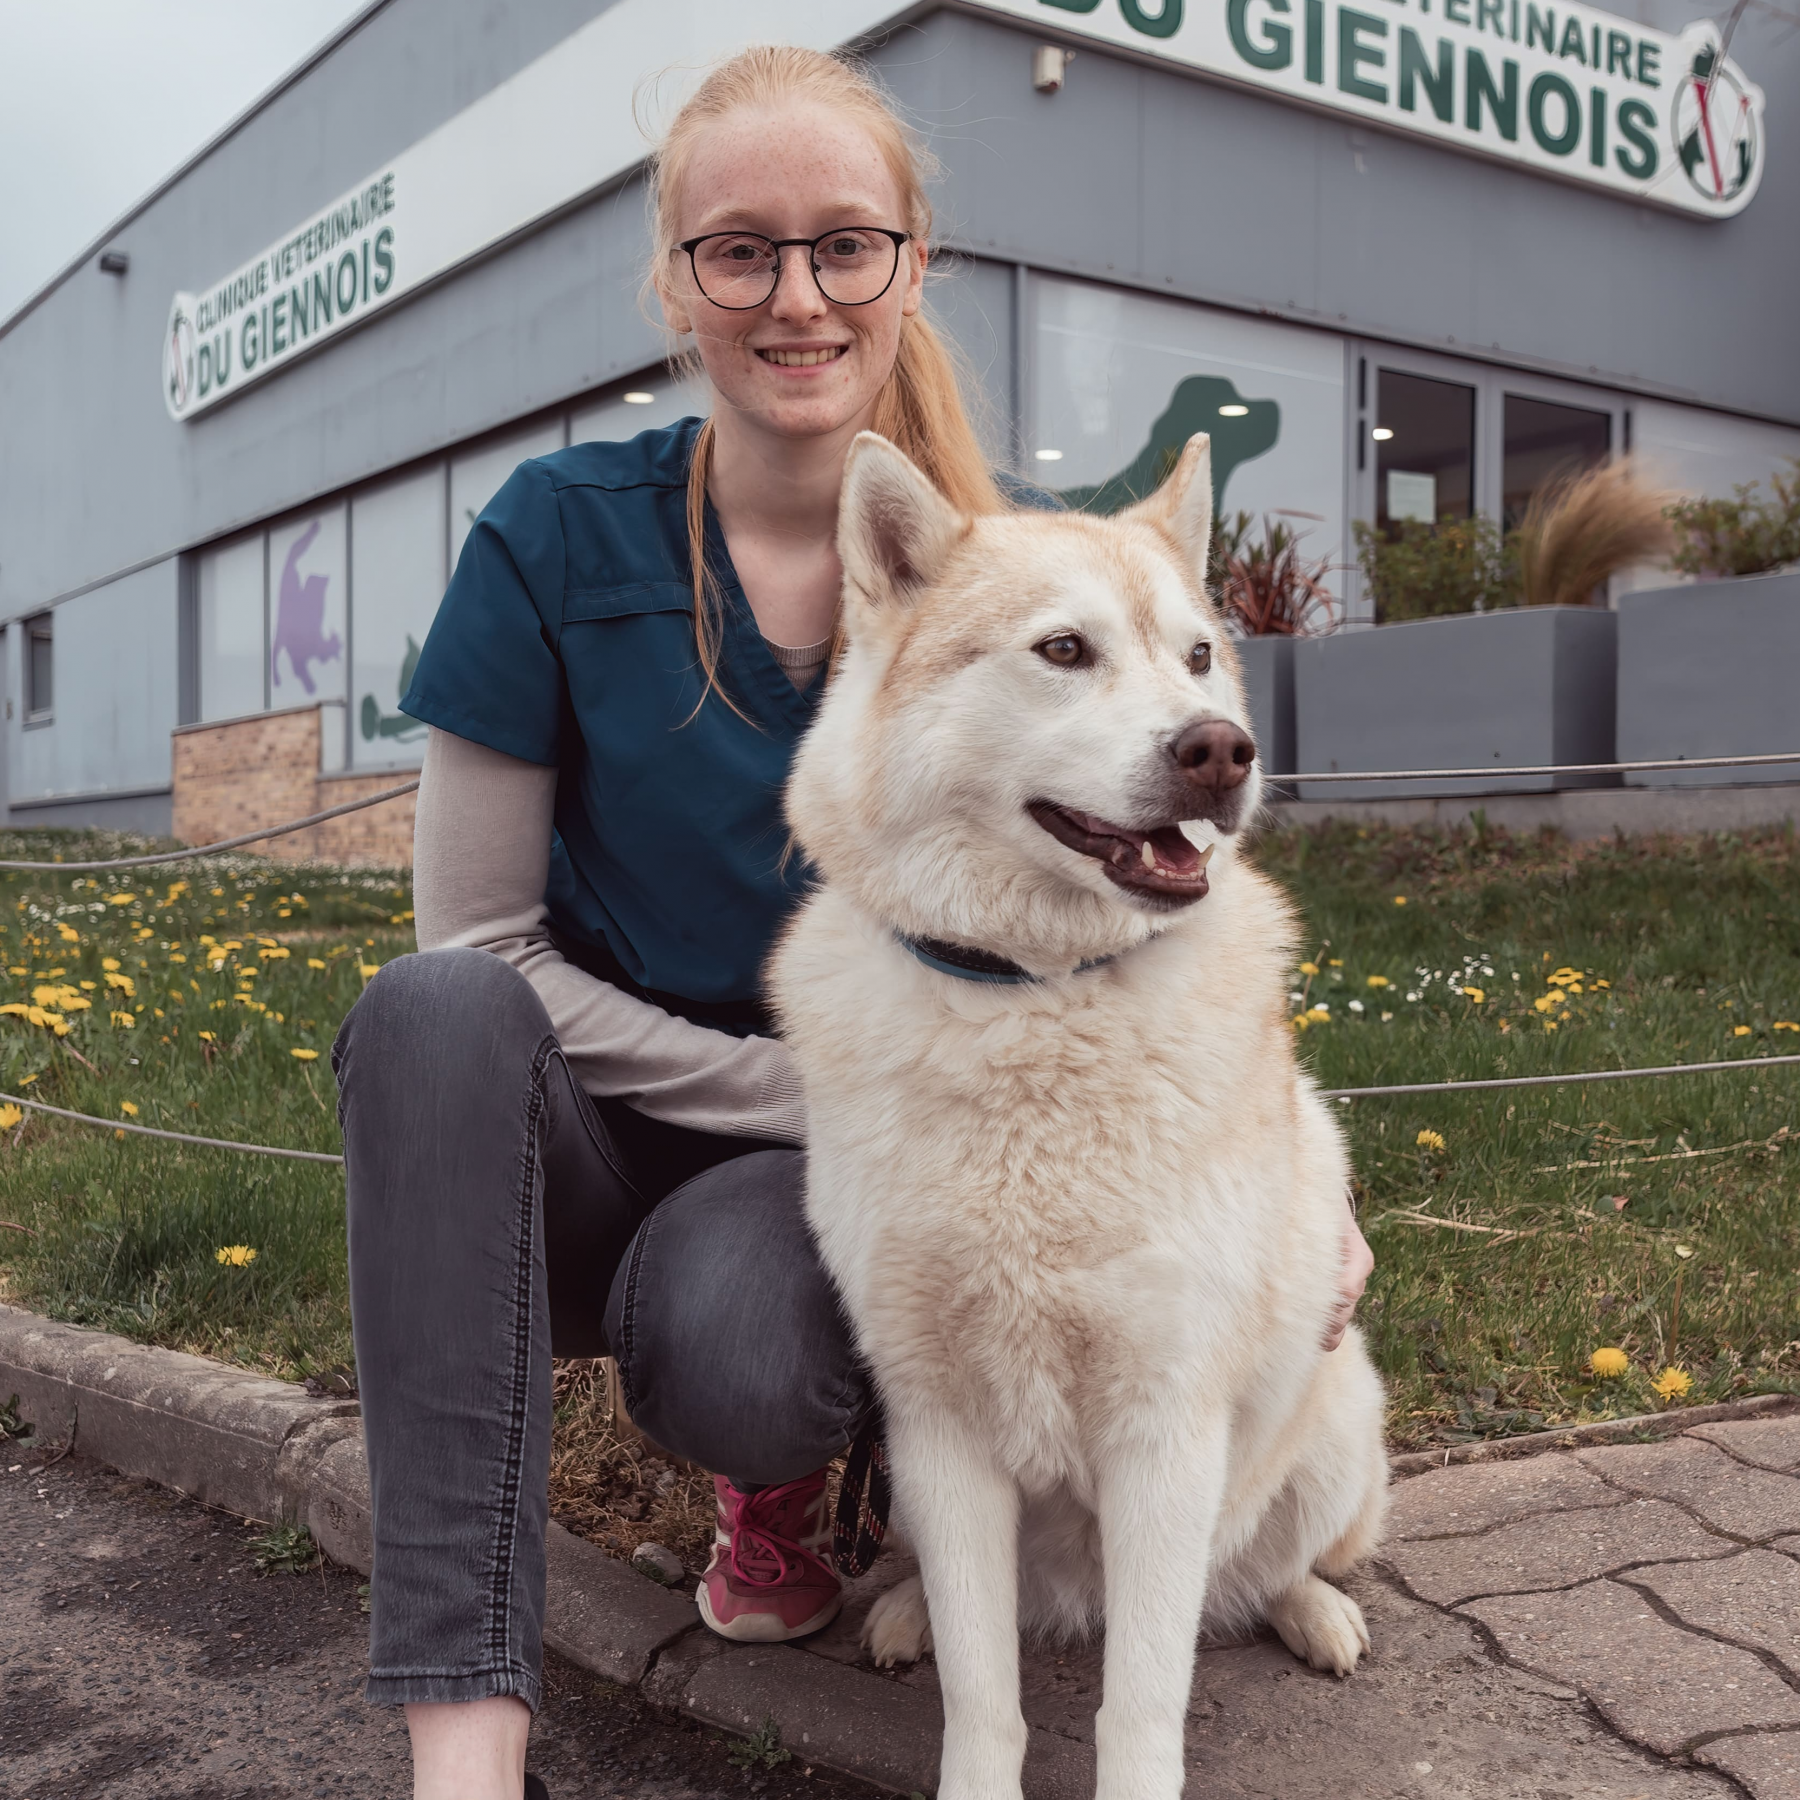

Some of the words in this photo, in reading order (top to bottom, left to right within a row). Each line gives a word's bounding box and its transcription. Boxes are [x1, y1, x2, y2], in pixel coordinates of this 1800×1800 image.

[1226, 0, 1659, 181] GIENNOIS
[1384, 0, 1662, 89] ERINAIRE
[196, 259, 269, 334] CLINIQUE
[270, 170, 396, 284] VETERINAIRE
[198, 326, 233, 398] DU
[239, 225, 395, 374] GIENNOIS
